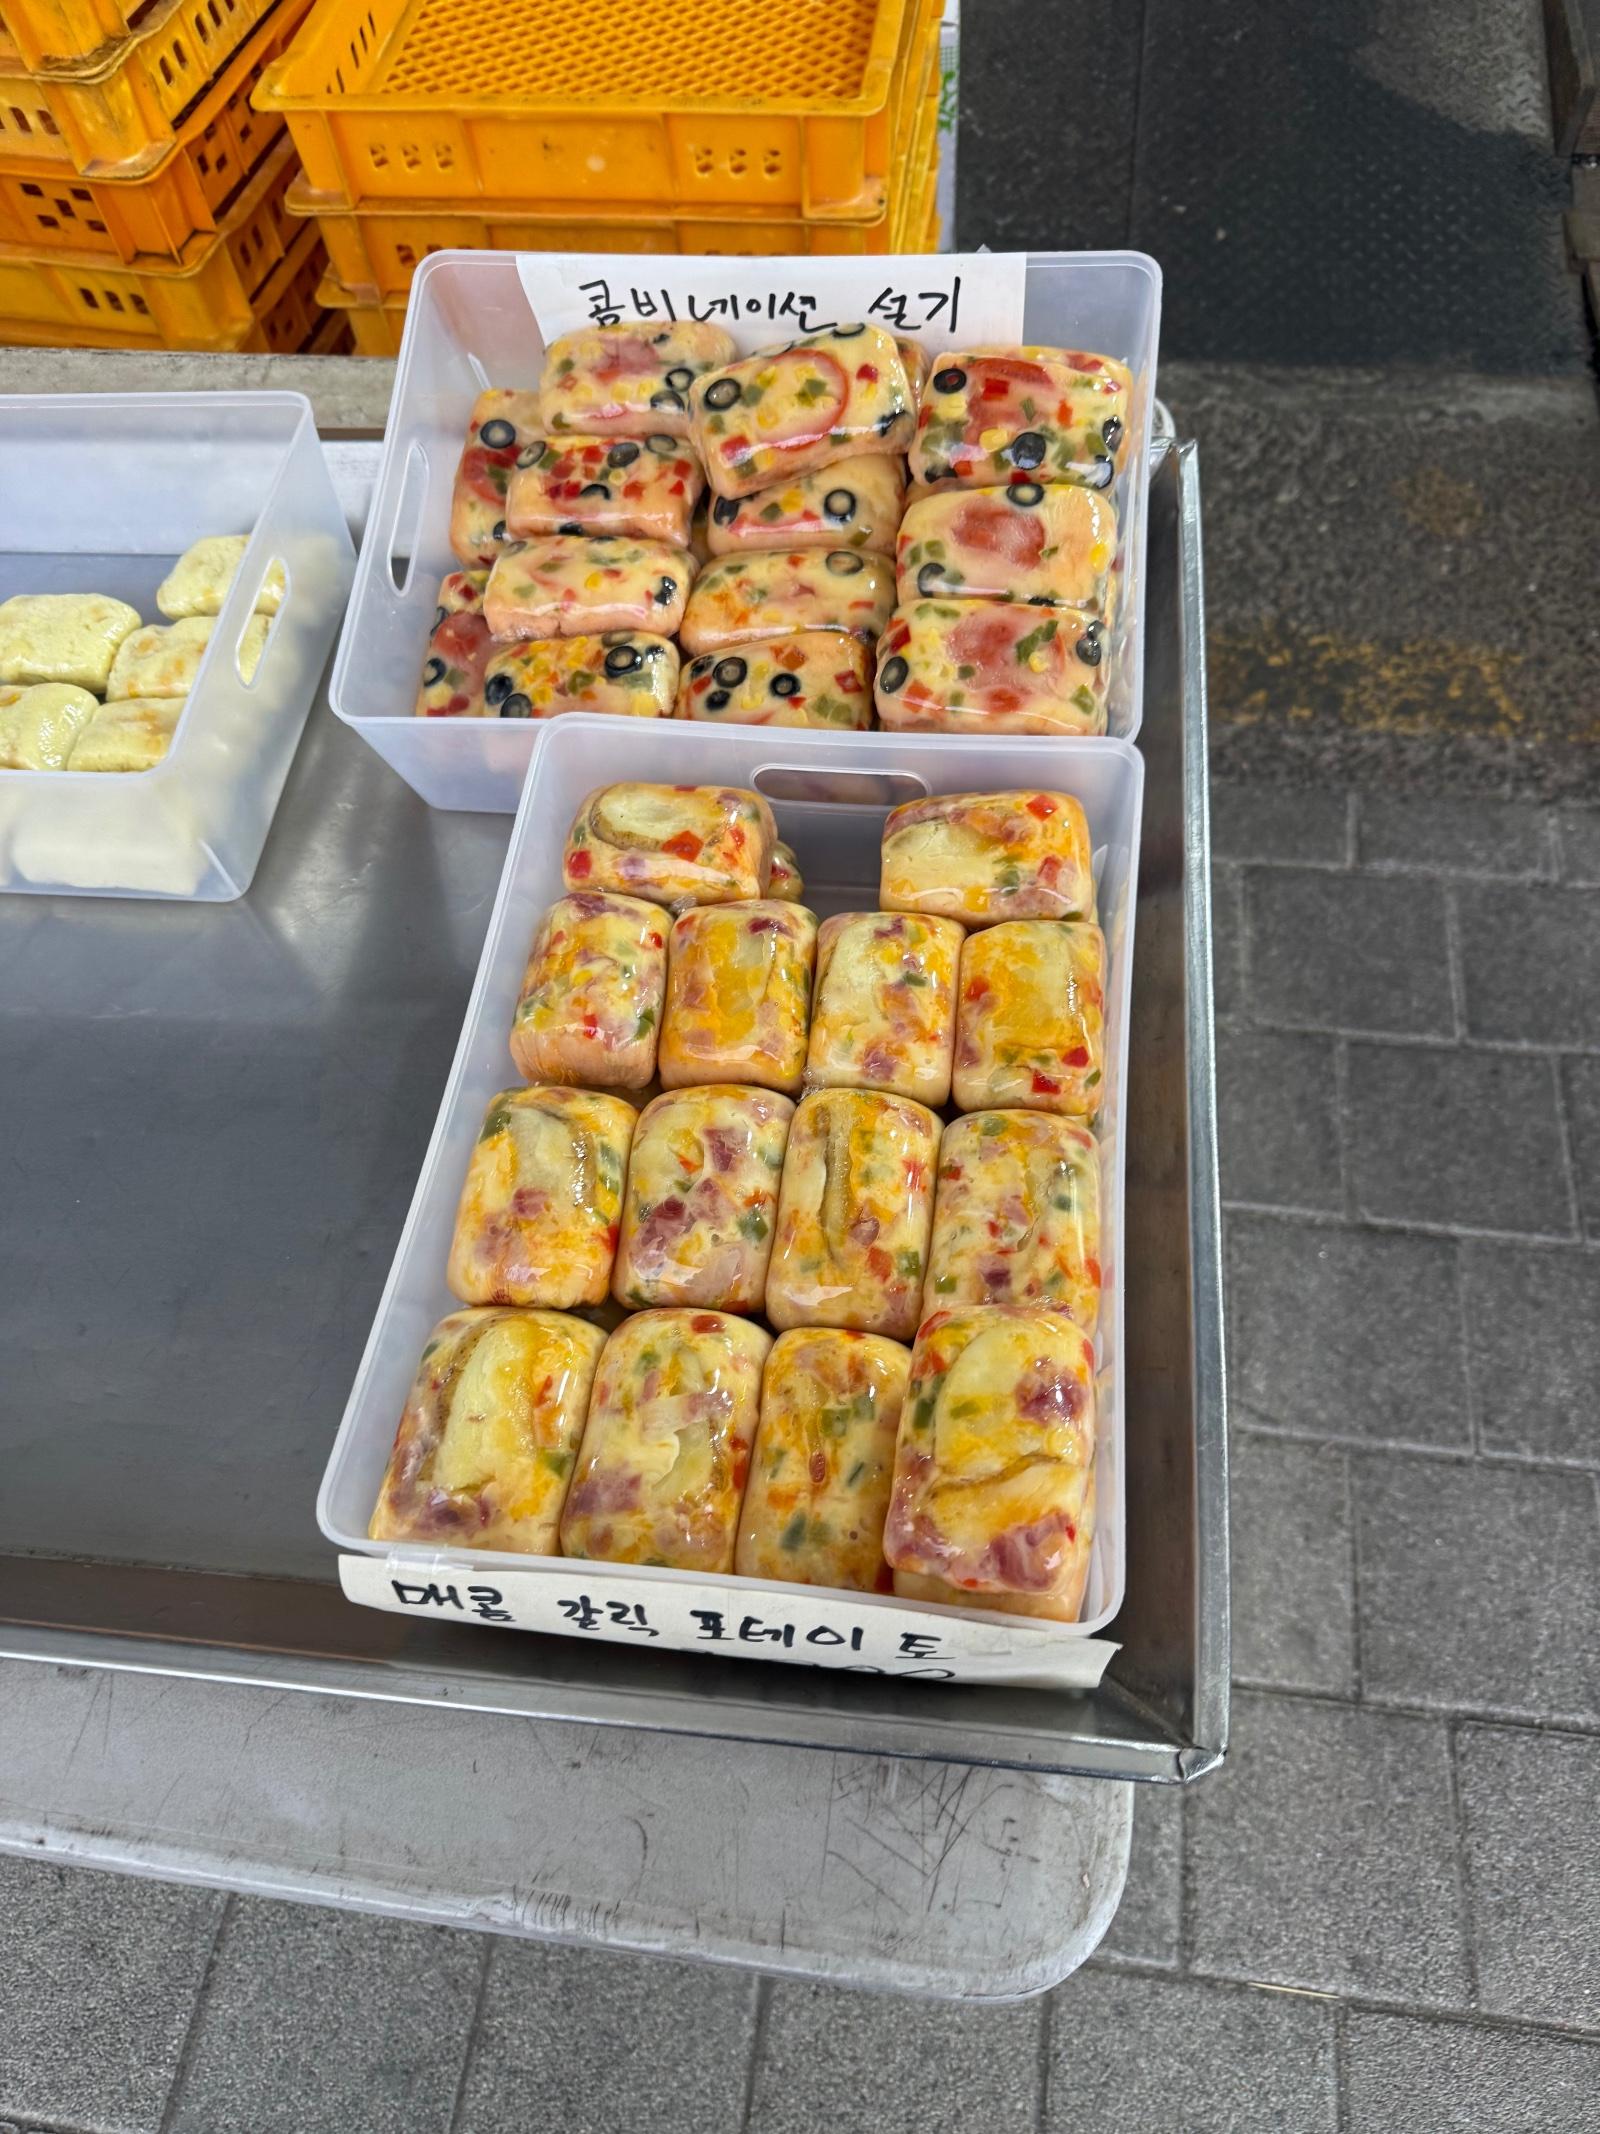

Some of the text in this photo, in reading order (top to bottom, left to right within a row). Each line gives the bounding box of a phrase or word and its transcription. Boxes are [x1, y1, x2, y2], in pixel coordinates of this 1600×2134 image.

[579, 275, 961, 333] 콤비네이션 설기
[391, 1580, 516, 1622] 매콤
[557, 1595, 660, 1637] 갈릭
